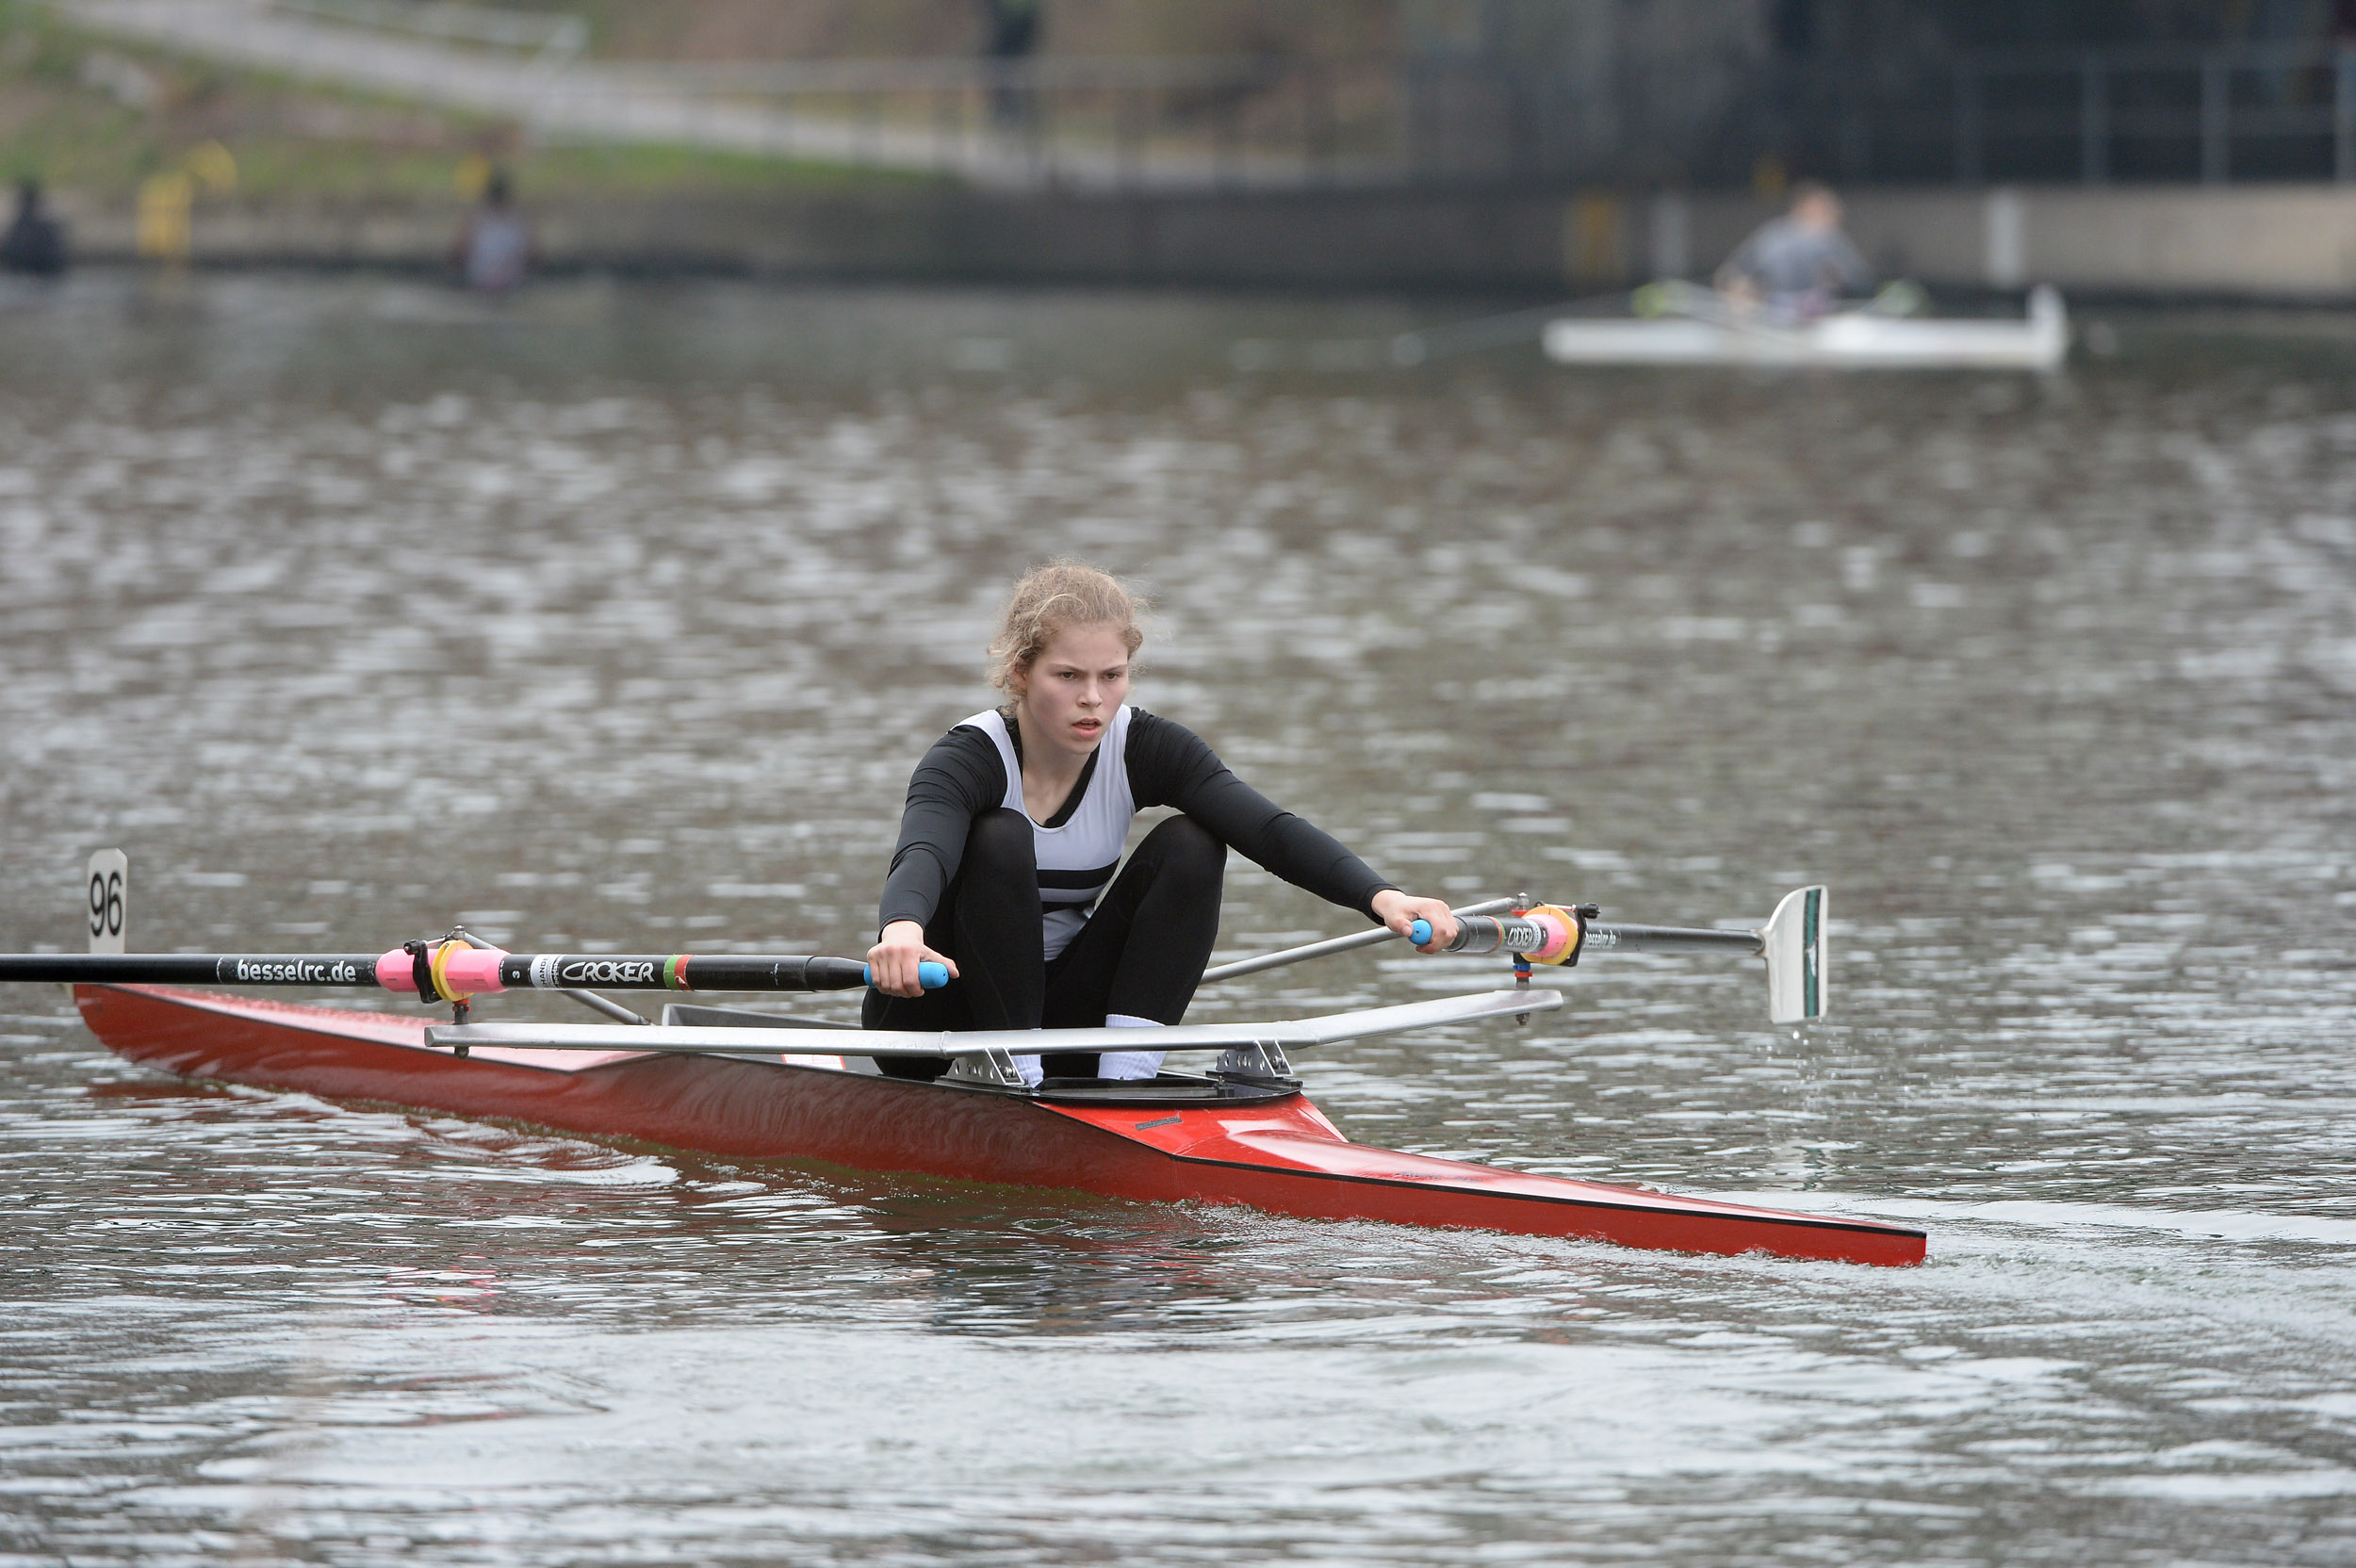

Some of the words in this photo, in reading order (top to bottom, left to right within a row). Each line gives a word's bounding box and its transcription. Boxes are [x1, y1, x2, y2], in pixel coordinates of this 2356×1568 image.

[90, 872, 123, 937] 96
[237, 958, 356, 982] besselrc.de
[562, 961, 655, 982] CROKER
